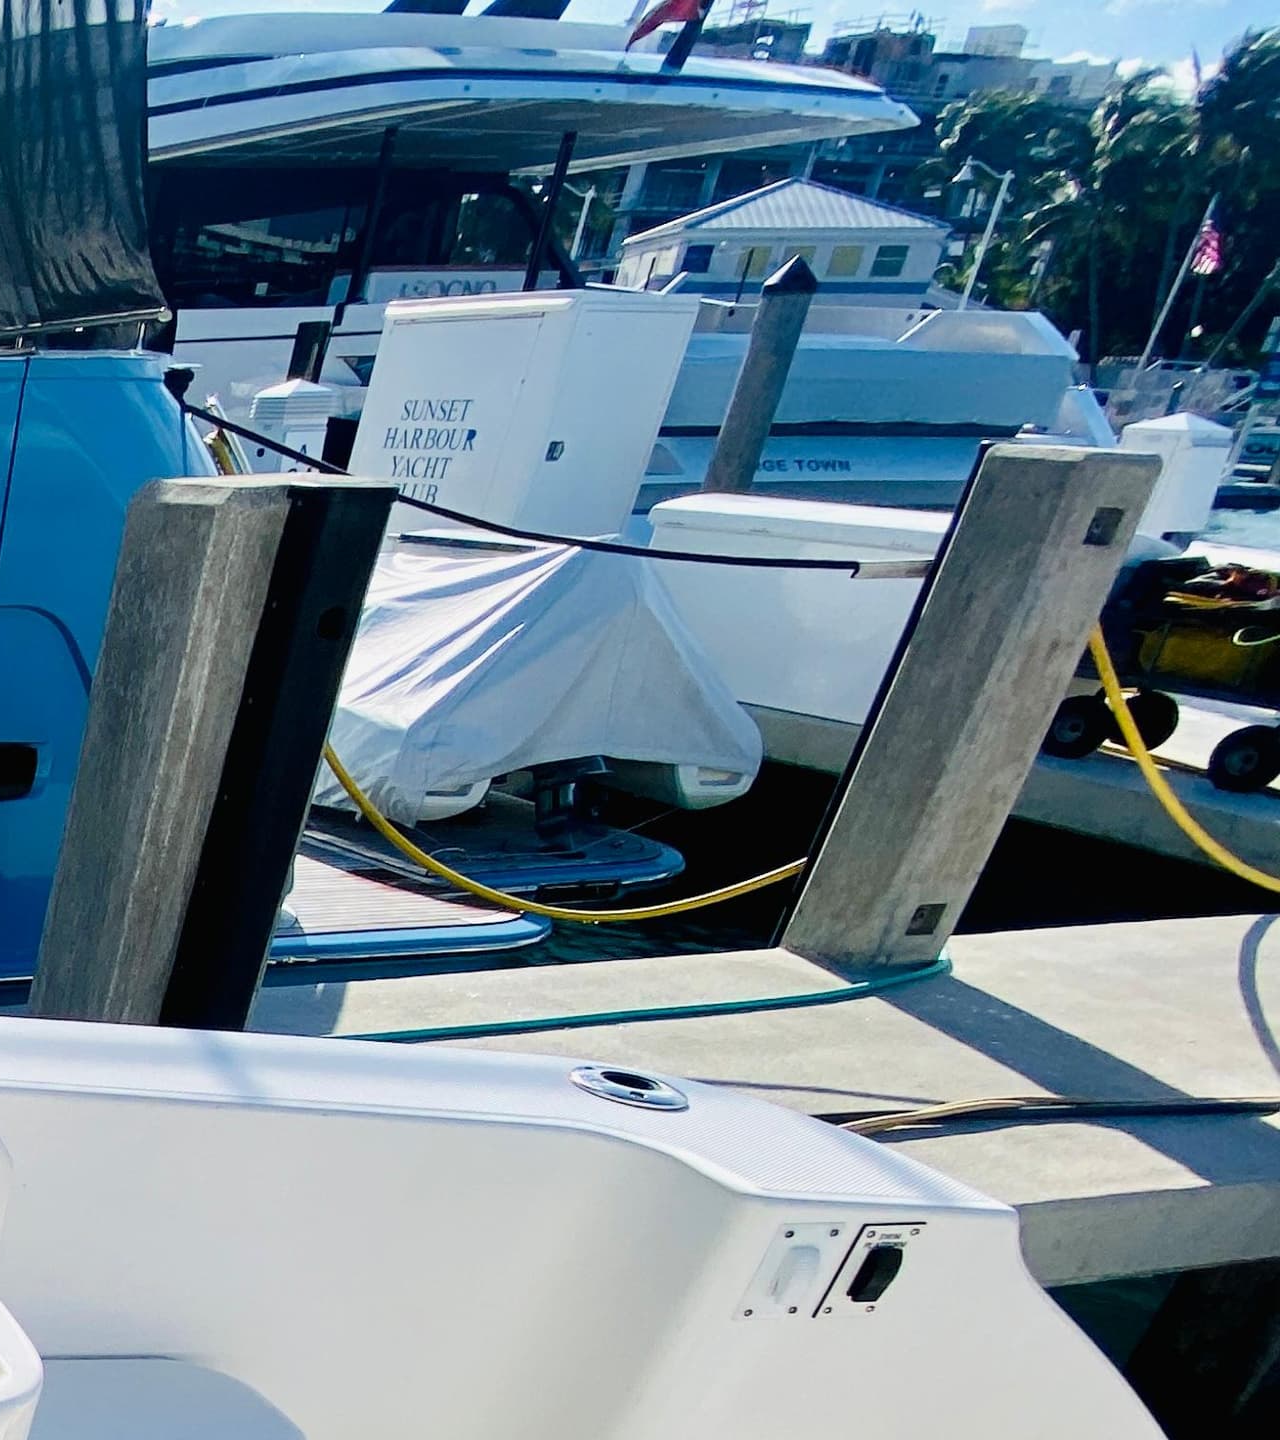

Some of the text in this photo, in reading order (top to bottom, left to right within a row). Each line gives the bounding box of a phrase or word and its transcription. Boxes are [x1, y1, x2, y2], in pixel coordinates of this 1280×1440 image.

[401, 399, 474, 421] SUNSET
[383, 427, 477, 451] HARBOUR
[391, 455, 453, 479] YACHT
[758, 459, 851, 473] GE TOWN
[395, 482, 438, 504] LUB
